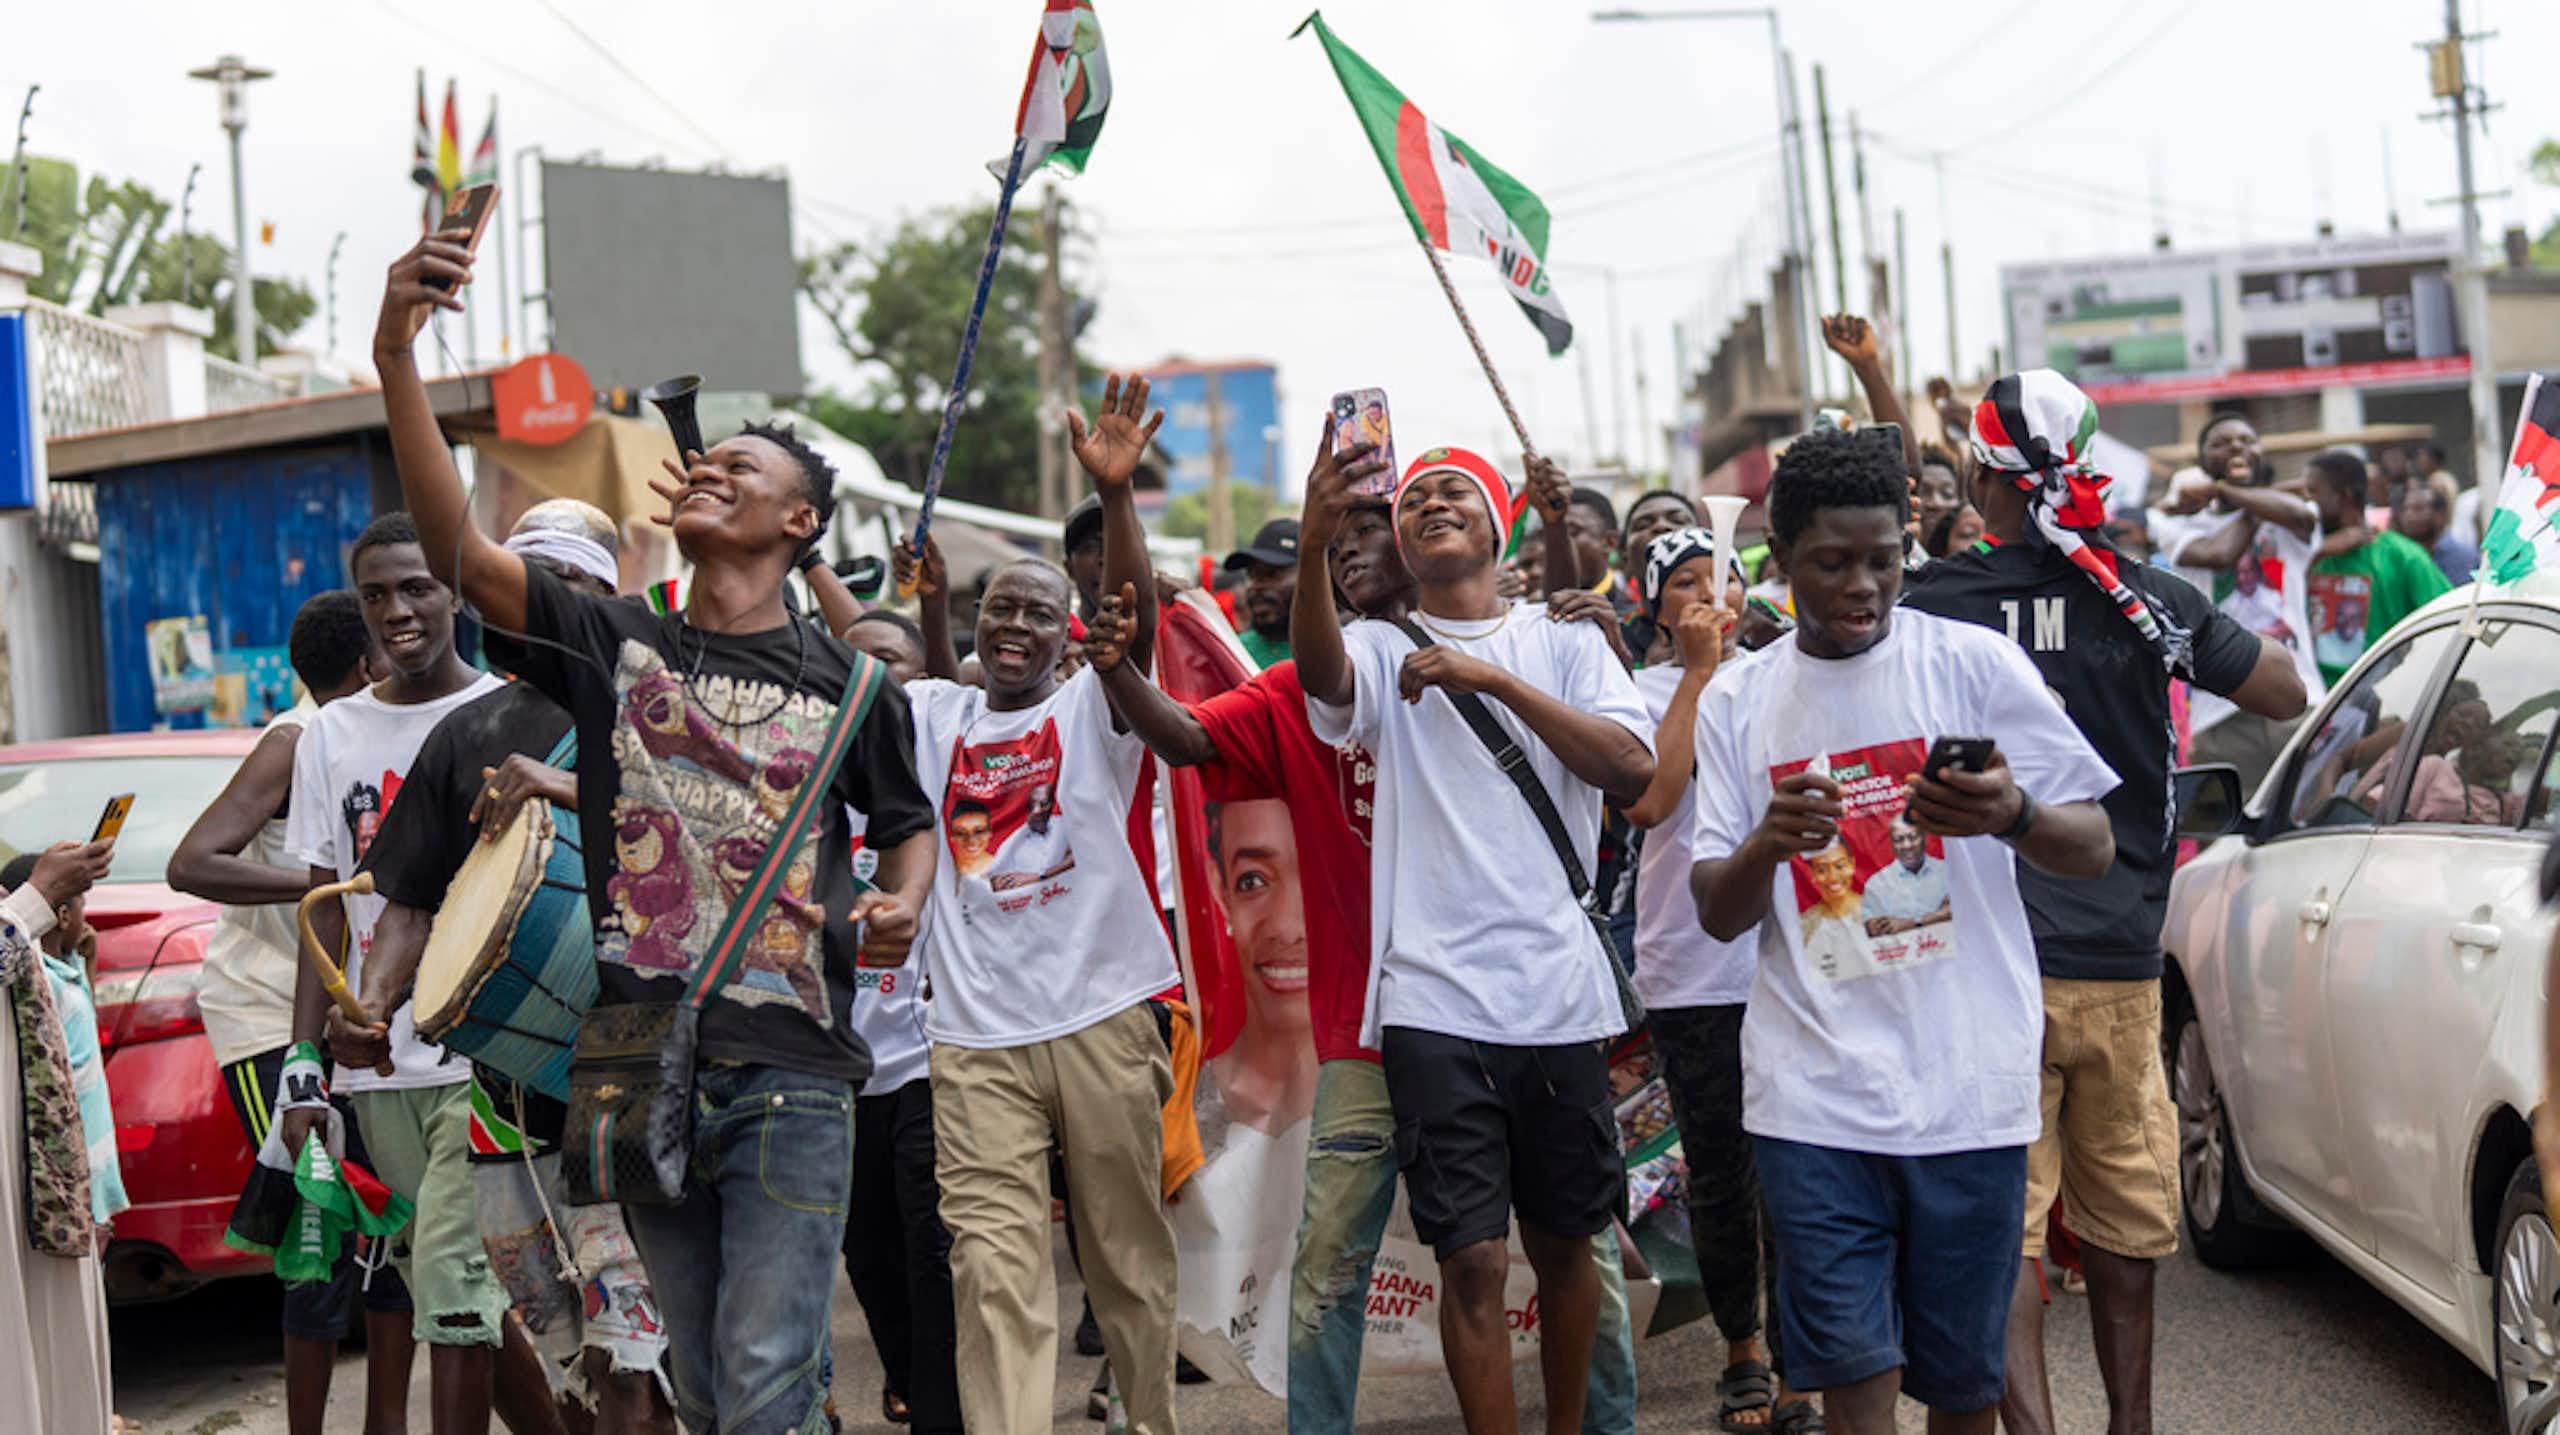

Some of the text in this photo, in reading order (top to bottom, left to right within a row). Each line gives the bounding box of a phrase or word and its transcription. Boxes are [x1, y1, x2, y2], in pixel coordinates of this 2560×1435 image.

[1500, 246, 1550, 297] NDC
[1369, 1271, 1434, 1303] HANA
[1365, 1296, 1422, 1318] ANT
